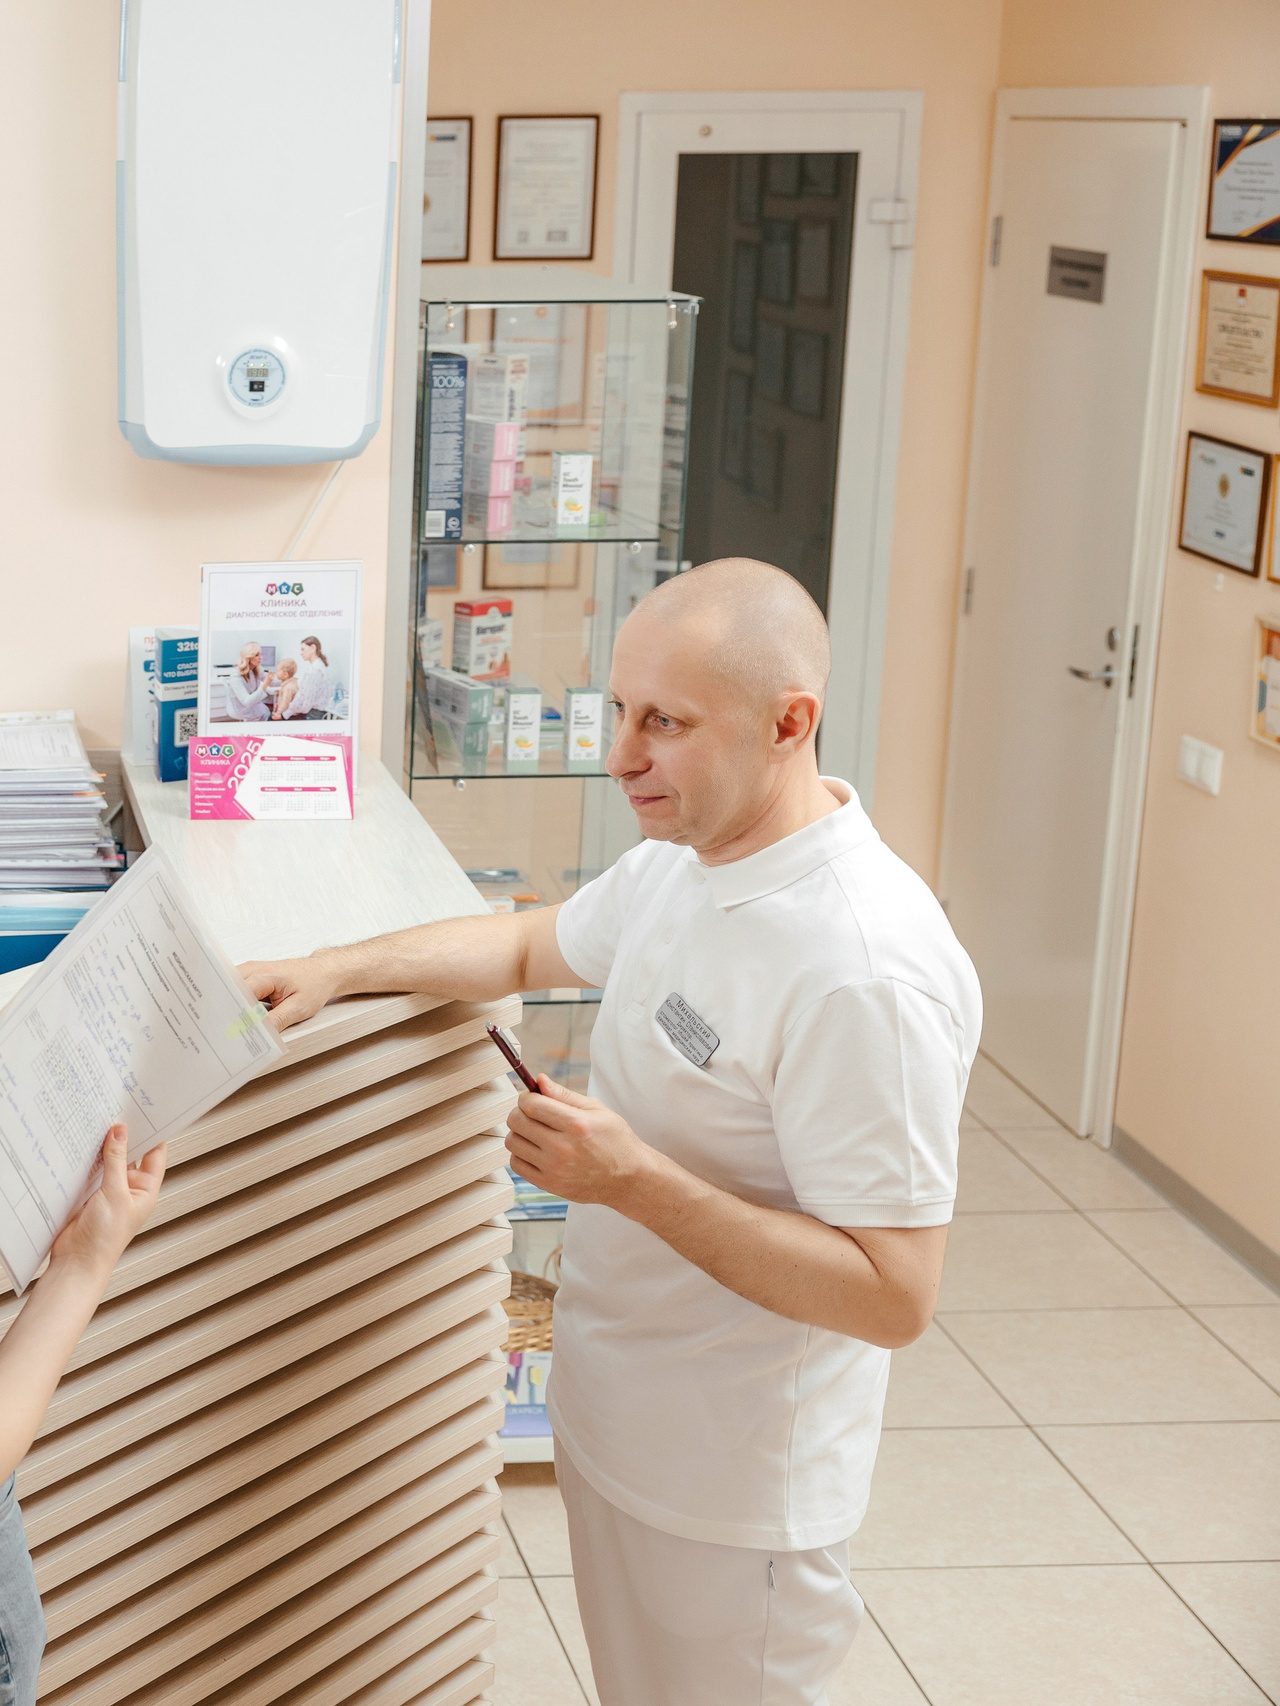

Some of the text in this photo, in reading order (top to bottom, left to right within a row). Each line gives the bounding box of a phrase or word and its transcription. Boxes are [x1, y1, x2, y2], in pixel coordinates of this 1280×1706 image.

[432, 375, 465, 388] 100%
[267, 584, 302, 594] МКС
[260, 599, 307, 608] КЛИНИКА
[226, 610, 343, 619] ДИАГНОСТИЧЕСКОЕ ОТДЕЛЕНИЕ
[227, 740, 262, 791] 2025
[664, 998, 686, 1023] Константин
[675, 999, 711, 1039] Михальский
